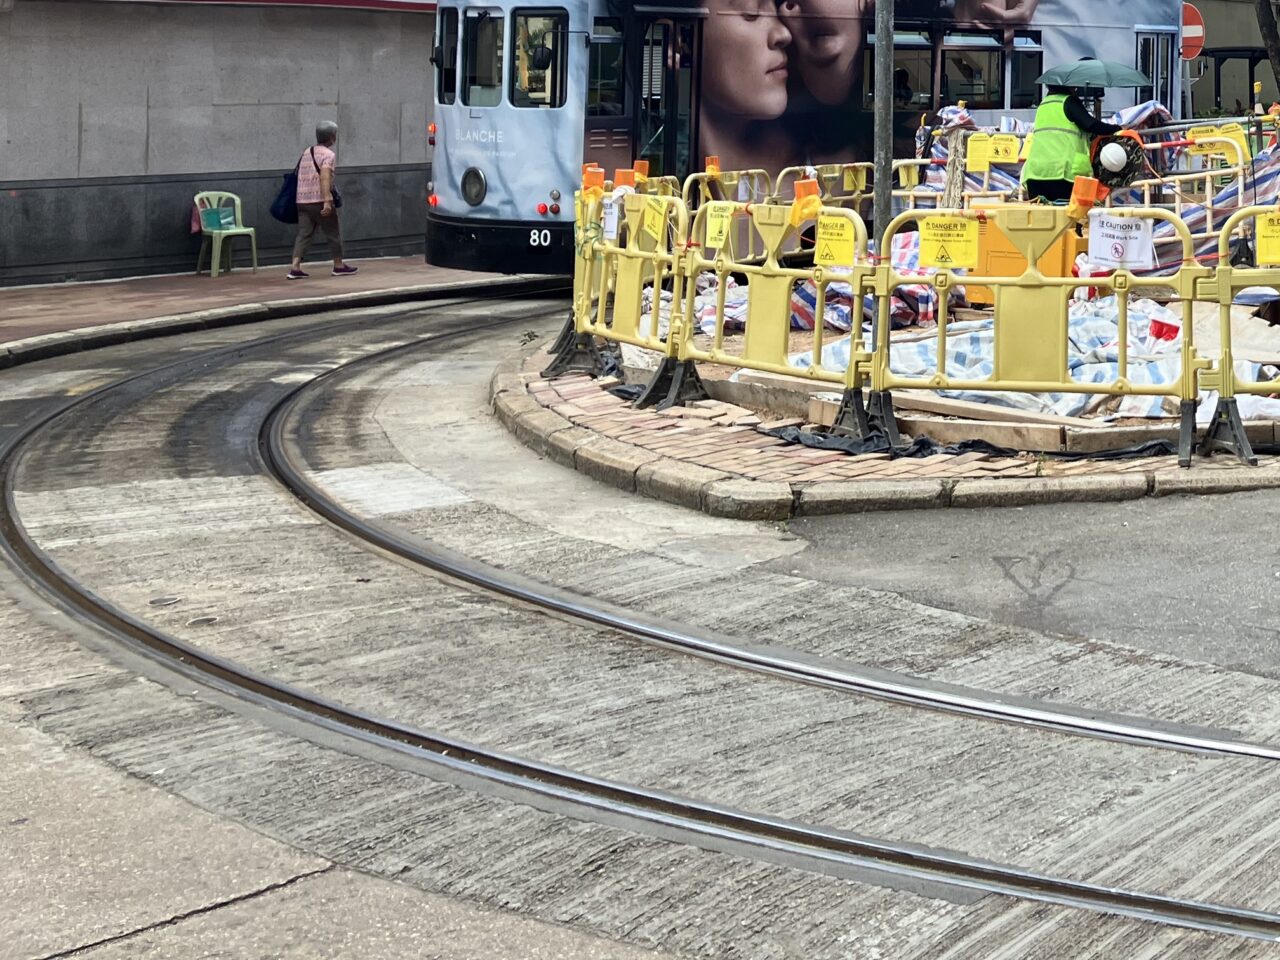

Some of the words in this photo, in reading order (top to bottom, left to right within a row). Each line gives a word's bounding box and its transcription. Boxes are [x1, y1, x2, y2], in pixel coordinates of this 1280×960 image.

[455, 128, 504, 143] BLANCHE
[931, 222, 958, 230] DANGER
[1105, 221, 1133, 231] CAUTION
[529, 229, 551, 246] 80
